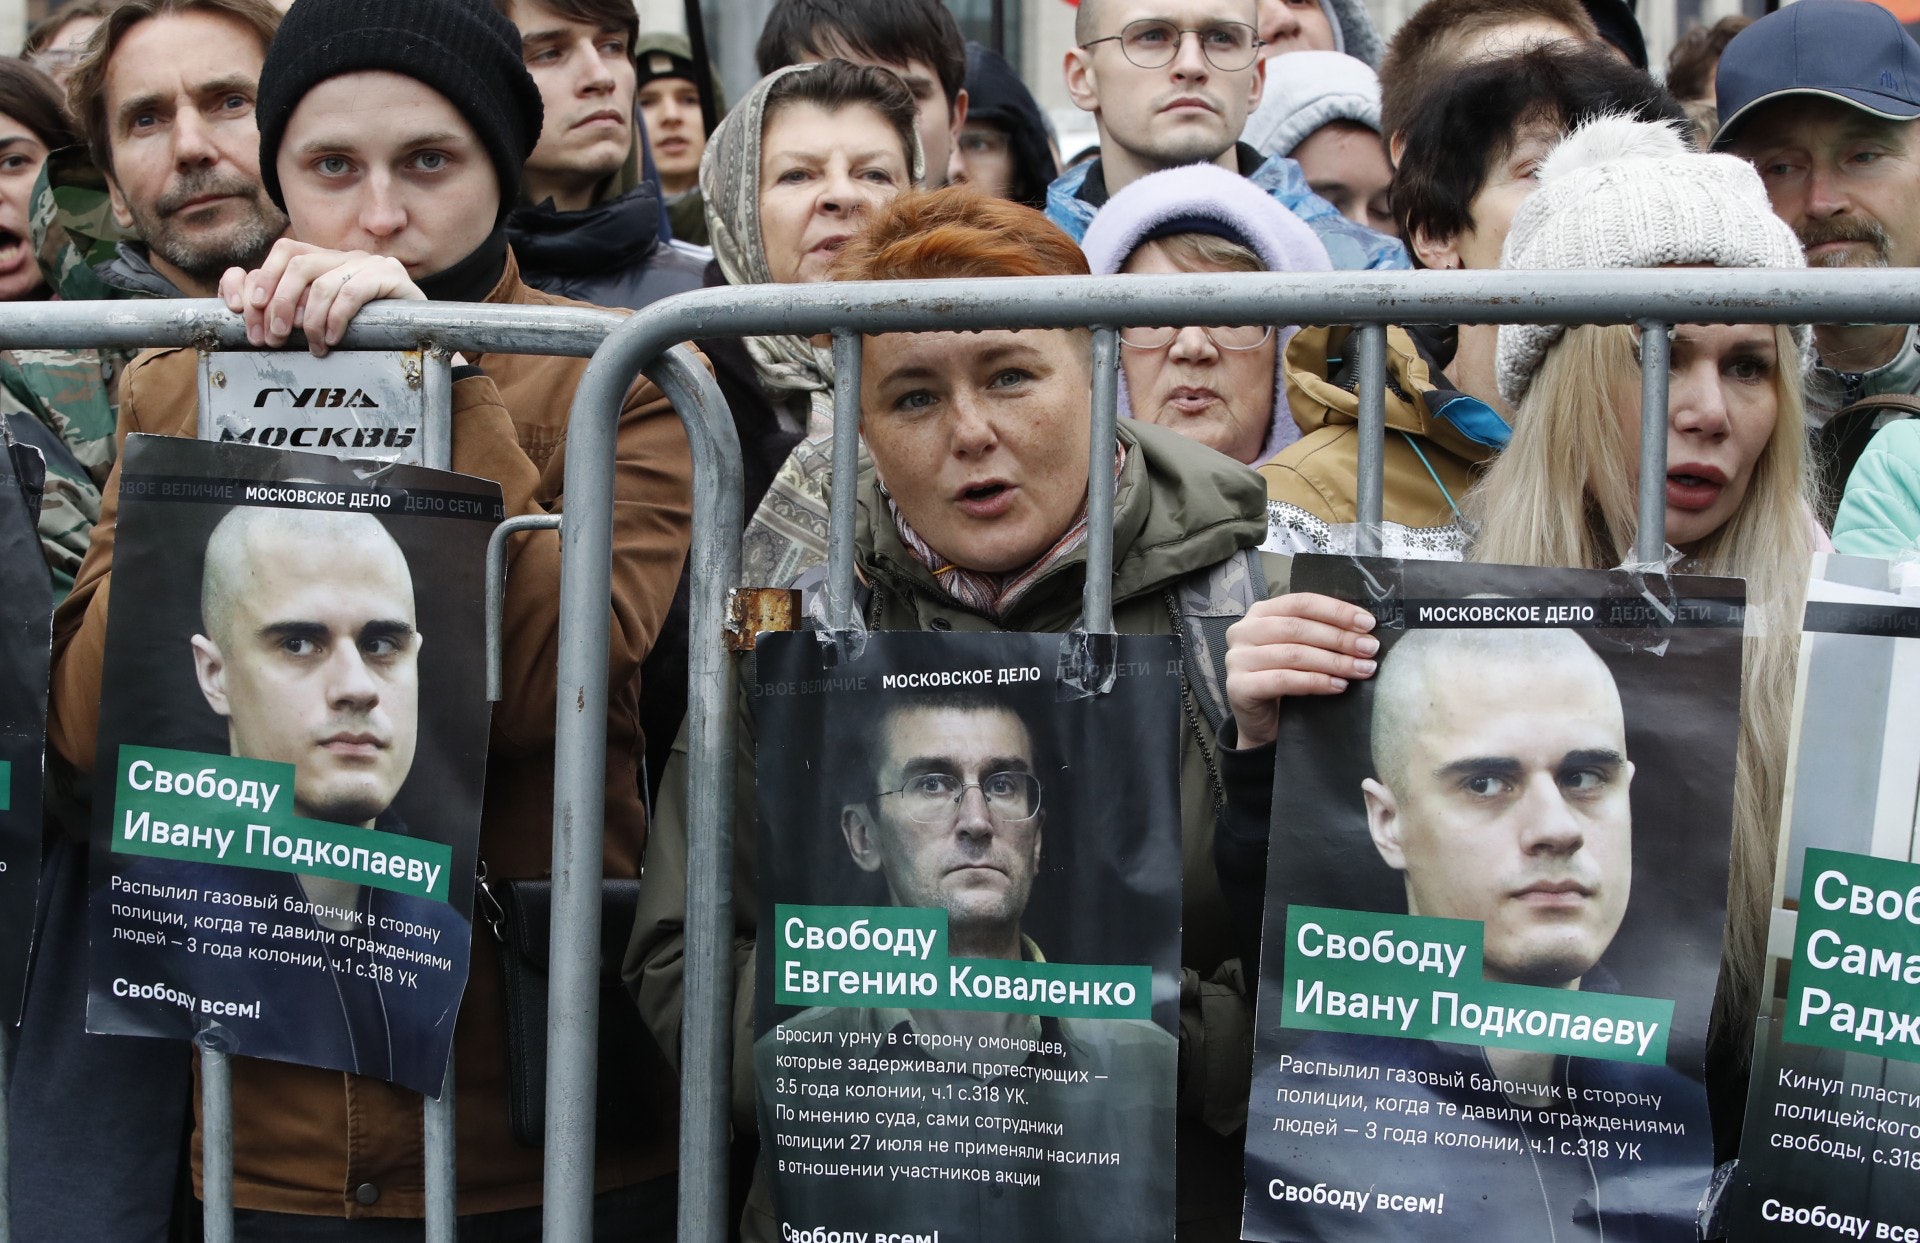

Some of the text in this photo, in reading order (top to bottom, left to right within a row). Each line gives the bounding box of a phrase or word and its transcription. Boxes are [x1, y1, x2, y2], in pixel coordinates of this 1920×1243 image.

[161, 482, 233, 498] ВЕЛИЧИЕ
[245, 486, 346, 506] МОСКОВСКОЕ
[349, 492, 391, 508] ДЕЛО
[404, 495, 444, 512] ДЕЛО
[448, 499, 483, 515] СЕТИ
[1419, 606, 1540, 622] МОСКОВСКОЕ
[1545, 606, 1594, 624] ДЕЛО
[801, 677, 868, 695] ВЕЛИЧИЕ
[883, 669, 993, 689] МОСКОВСКОЕ
[997, 667, 1041, 685] ДЕЛО
[128, 759, 280, 813] Свободу
[123, 809, 442, 894] Ивану Подкопаеву
[111, 875, 441, 945] Распылил газовый балончик в сторону
[111, 903, 452, 972] полиции, когда те давили ограждениями
[112, 926, 166, 946] людей
[186, 937, 197, 953] 3
[202, 942, 243, 959] года
[248, 946, 327, 972] колонии,
[331, 958, 351, 974] ч.1
[355, 962, 394, 983] с.318
[398, 969, 418, 990] УК
[784, 917, 937, 960] Свободу
[1297, 922, 1467, 978] Свободу
[112, 977, 261, 1020] Свободу всем!
[784, 961, 1136, 1006] Евгению Коваленко
[1295, 979, 1659, 1057] Ивану Подкопаеву
[776, 1025, 1067, 1058] Бросил урну в сторону омоновцев,
[776, 1055, 842, 1073] которые
[847, 1057, 967, 1075] задерживали
[972, 1062, 1089, 1084] протестующих
[1279, 1054, 1662, 1111] Распылил газовый балончик в сторону
[1778, 1067, 1844, 1097] Кинул
[776, 1077, 1029, 1105] 3.5 года колонии, ч.1 с.318 УК.
[1276, 1088, 1685, 1136] полиции, когда те давили ограждениями
[776, 1103, 1064, 1136] По мнению суда, сами сотрудники
[1272, 1117, 1338, 1136] людей
[1364, 1121, 1377, 1140] 3
[1383, 1126, 1427, 1145] года
[1434, 1131, 1524, 1155] колонии,
[1530, 1136, 1554, 1154] ч.1
[1560, 1138, 1609, 1158] с.318
[1615, 1141, 1642, 1161] УК
[1774, 1102, 1920, 1139] полицейского
[776, 1133, 1120, 1165] полиции 27 июля не применяли насилия
[1770, 1133, 1920, 1171] свободы, с.318
[778, 1159, 1041, 1187] в отношении участников акции
[1268, 1178, 1445, 1215] Свободу всем!
[1761, 1198, 1871, 1240] Свободу
